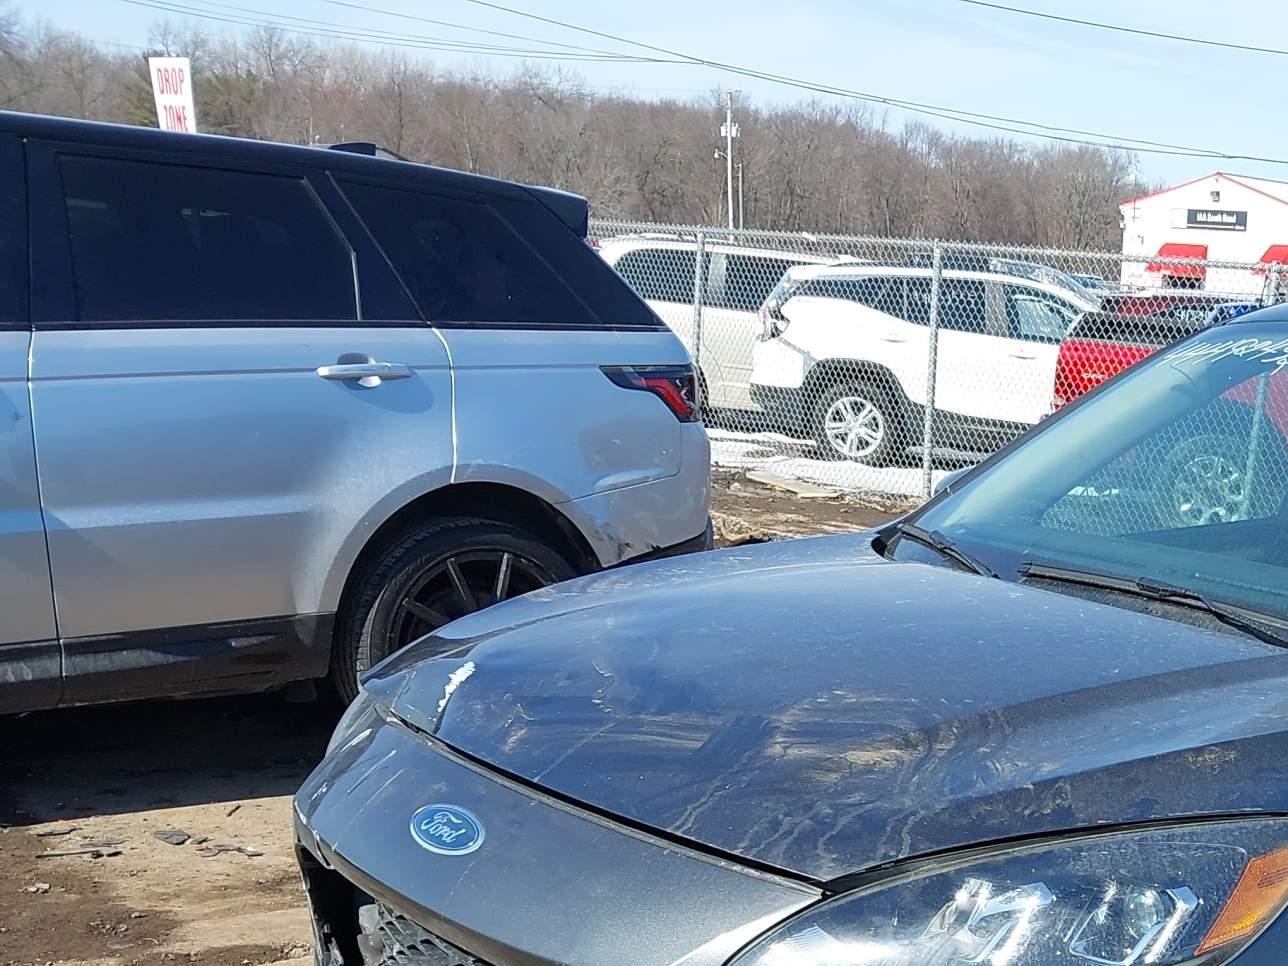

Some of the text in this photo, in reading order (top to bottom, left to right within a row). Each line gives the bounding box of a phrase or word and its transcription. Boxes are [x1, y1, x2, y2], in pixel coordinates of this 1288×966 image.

[156, 67, 185, 95] DROP
[163, 104, 188, 133] ZONE
[421, 811, 467, 843] Ford
